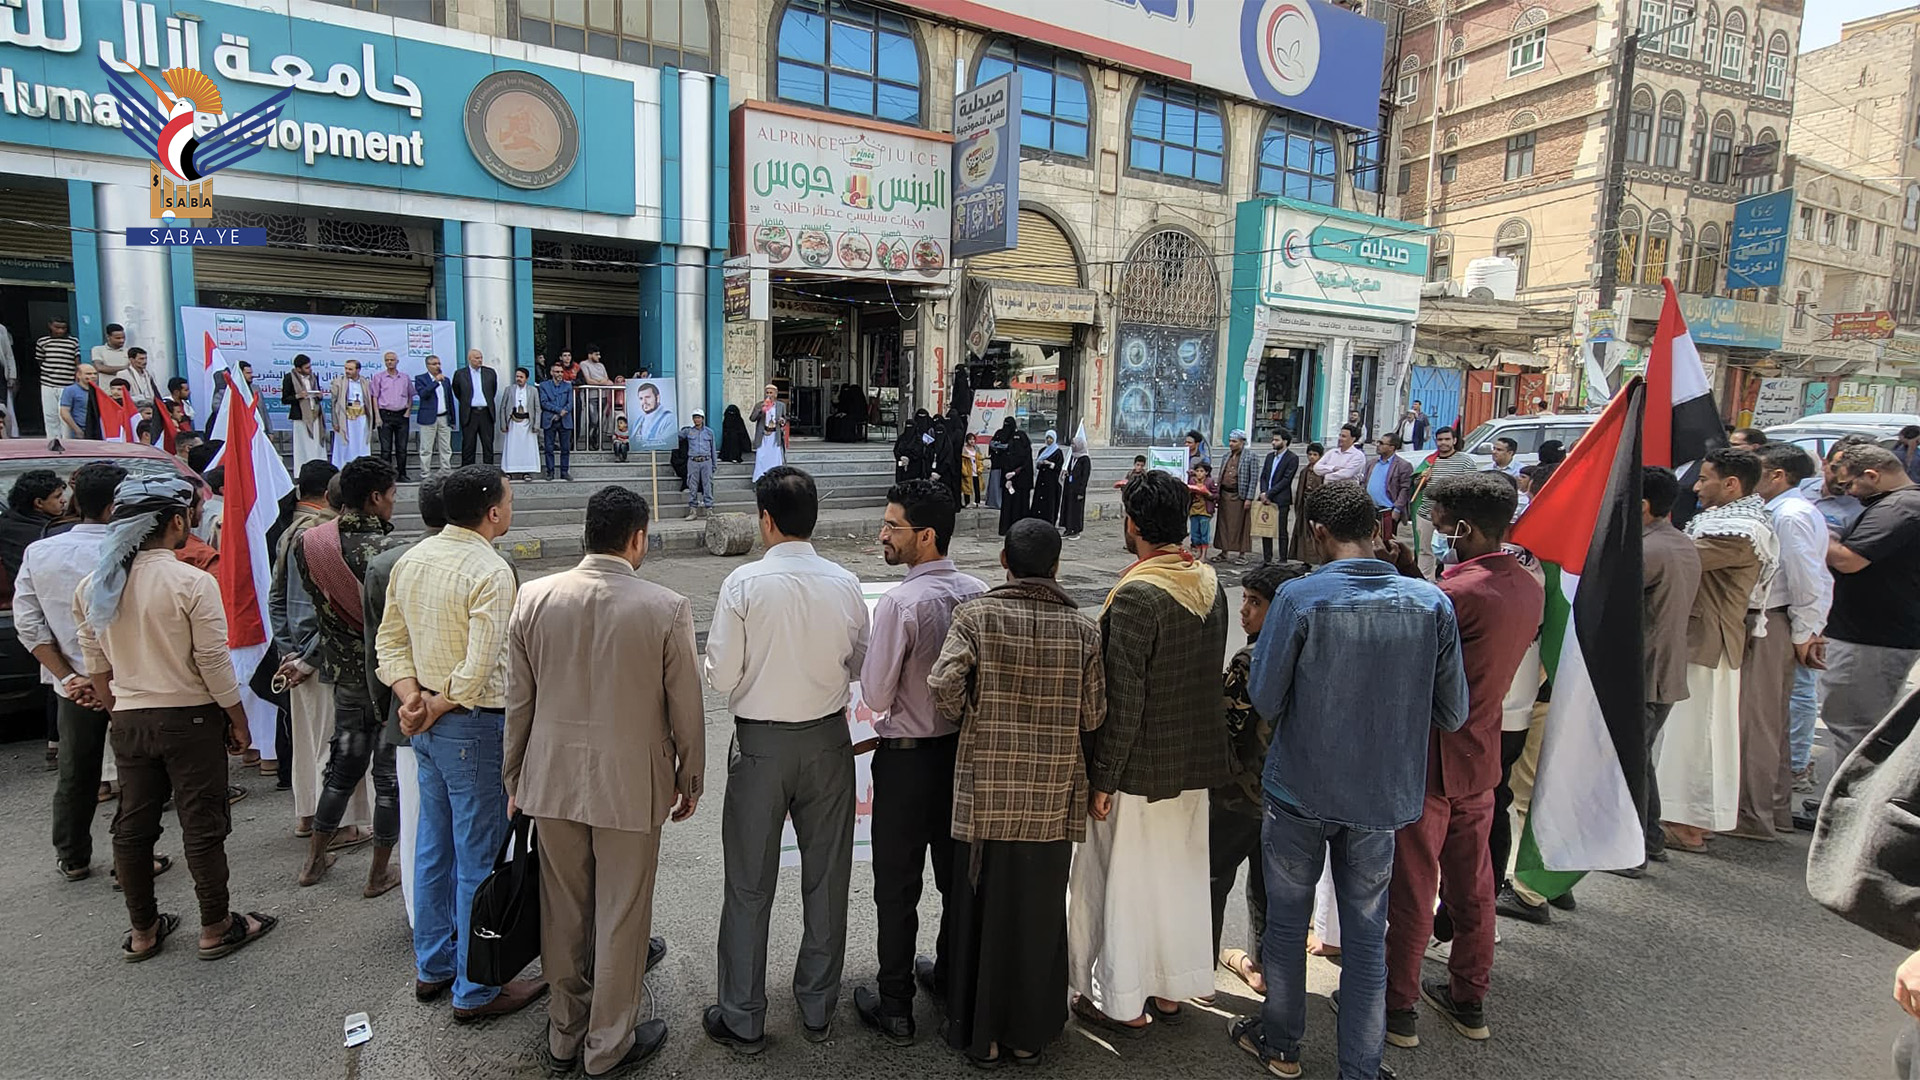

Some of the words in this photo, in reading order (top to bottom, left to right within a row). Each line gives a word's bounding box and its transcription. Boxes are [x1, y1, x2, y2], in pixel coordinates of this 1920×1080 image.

[214, 33, 425, 118] جامعة
[959, 89, 1004, 121] صيدلية
[757, 127, 839, 151] ALPRINCE
[753, 158, 835, 200] جوس
[878, 168, 946, 214] البرنس
[1739, 226, 1783, 240] صيدلية
[1360, 238, 1411, 267] صيدلية
[975, 393, 1007, 408] صيدلية
